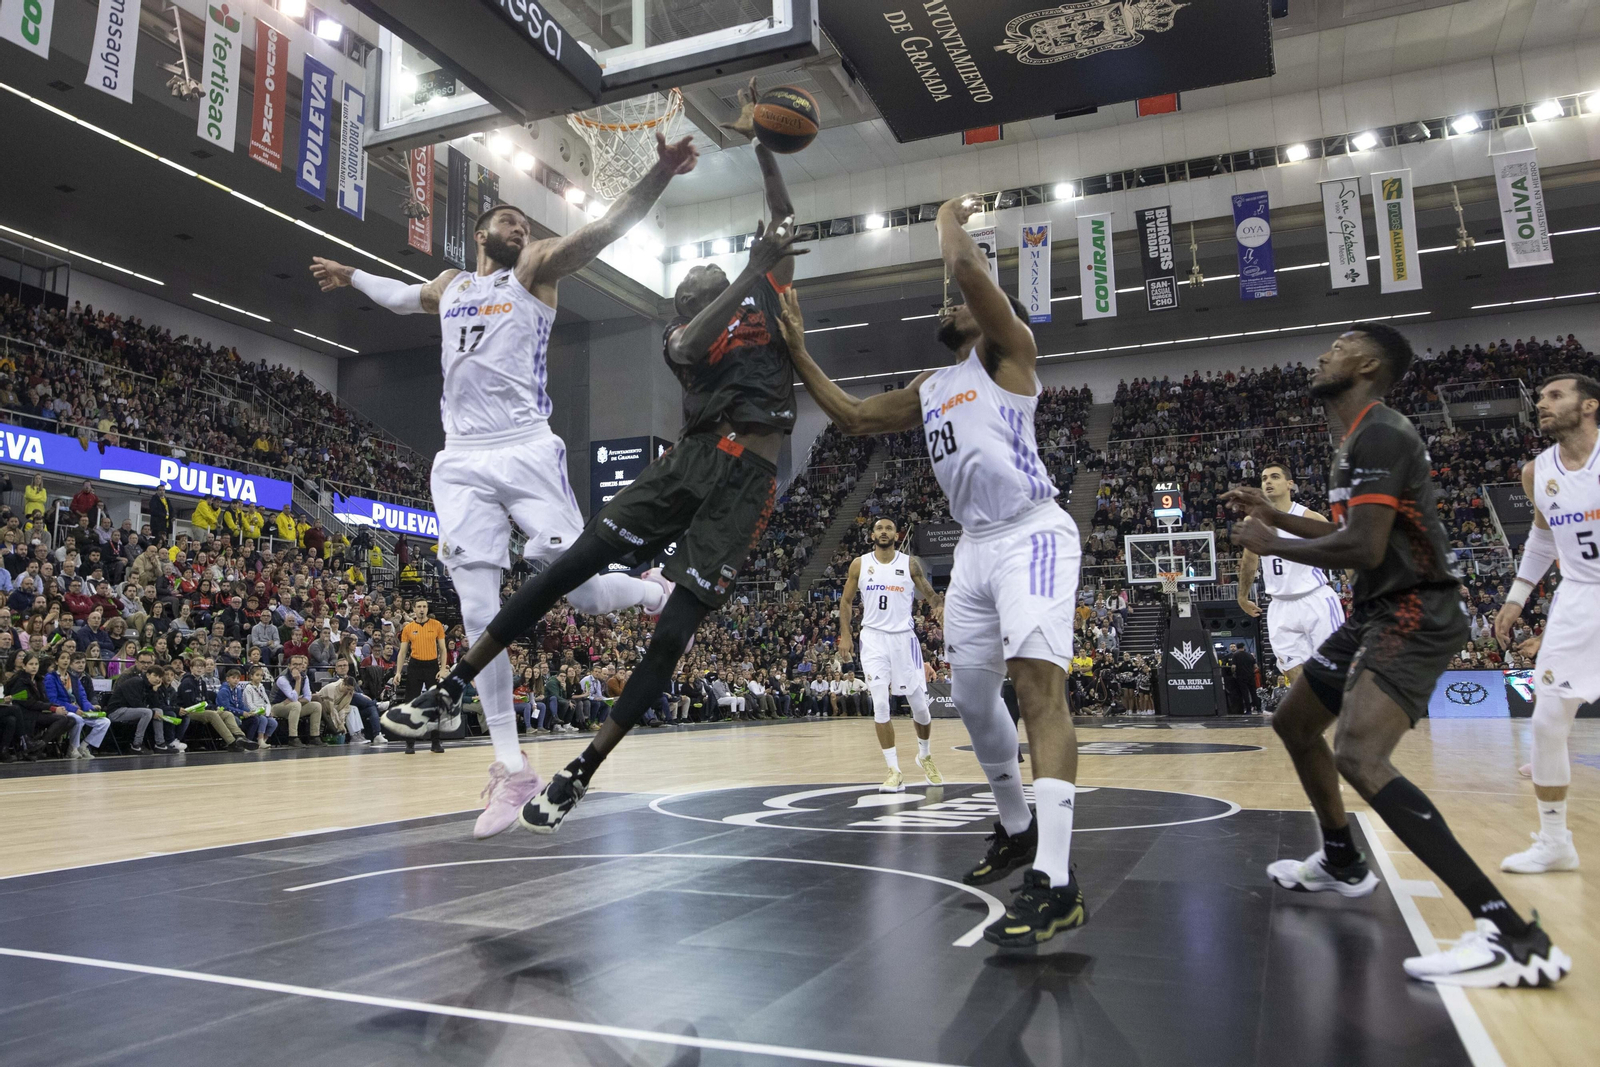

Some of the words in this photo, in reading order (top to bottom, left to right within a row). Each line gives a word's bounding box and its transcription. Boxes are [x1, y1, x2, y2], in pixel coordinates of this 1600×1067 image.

[265, 28, 278, 92] GRUPO
[883, 10, 914, 34] DE
[900, 36, 952, 103] GRANADA
[207, 33, 232, 141] fertisac
[302, 72, 328, 190] PULEVA
[347, 121, 359, 181] ABOGADOS
[1529, 161, 1540, 190] HIERRO
[1511, 176, 1535, 240] OLIVA
[1534, 189, 1541, 200] EN
[1144, 210, 1155, 220] DE
[1242, 225, 1264, 235] OYA
[1145, 221, 1160, 259] VERDAD
[1155, 208, 1174, 271] BURGERS
[1393, 231, 1405, 280] ALHAMBRA
[1030, 251, 1040, 312] MANZANO
[444, 302, 513, 319] AUTOHERO
[456, 325, 486, 353] 17
[929, 420, 957, 464] 28
[160, 459, 257, 503] PULEVA
[1155, 482, 1173, 490] 44.7
[1162, 495, 1173, 509] 9
[372, 503, 439, 536] PULEVA
[1576, 531, 1599, 560] 5
[1272, 558, 1283, 575] 6
[866, 584, 905, 593] AUTOHERO
[879, 595, 888, 610] 8
